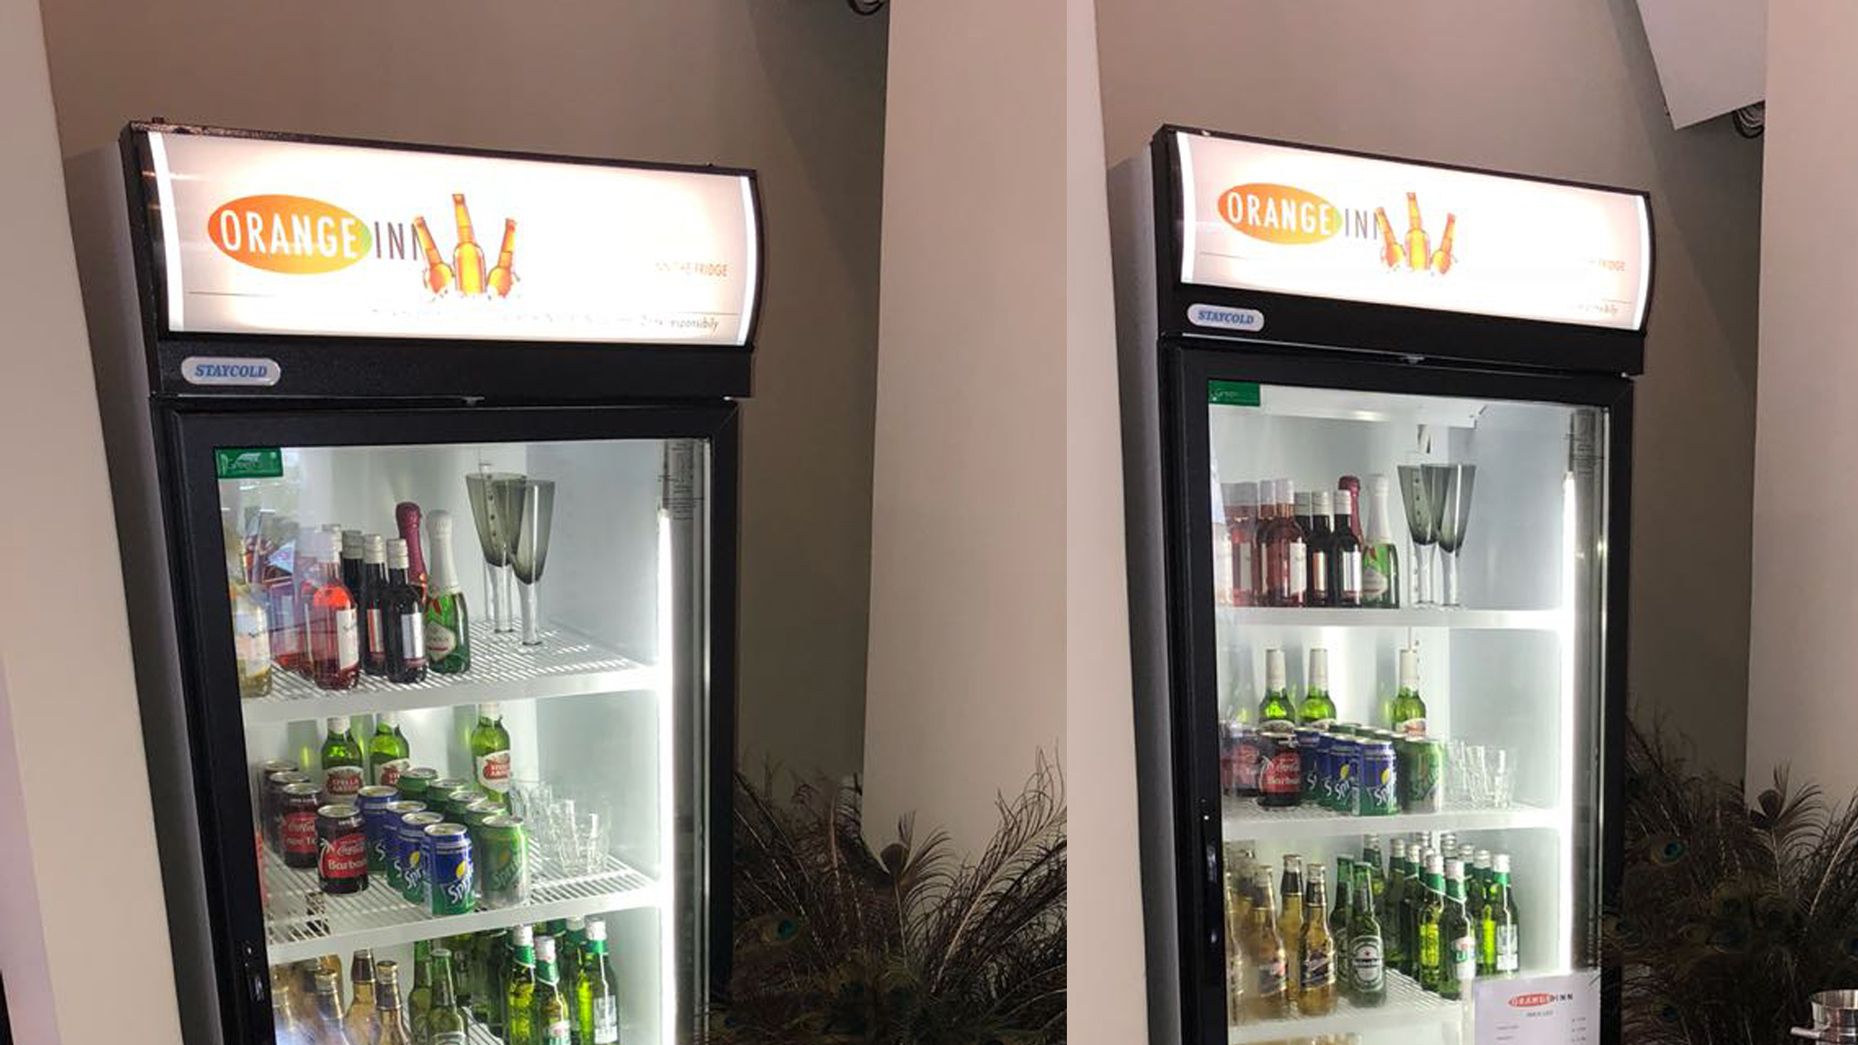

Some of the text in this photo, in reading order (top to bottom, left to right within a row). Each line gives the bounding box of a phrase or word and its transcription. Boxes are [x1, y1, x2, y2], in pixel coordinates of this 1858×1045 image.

[1227, 191, 1330, 236] ORANGE
[219, 209, 358, 259] ORANGE
[1198, 311, 1254, 324] STAYCOLD
[194, 363, 268, 378] STAYCOLD
